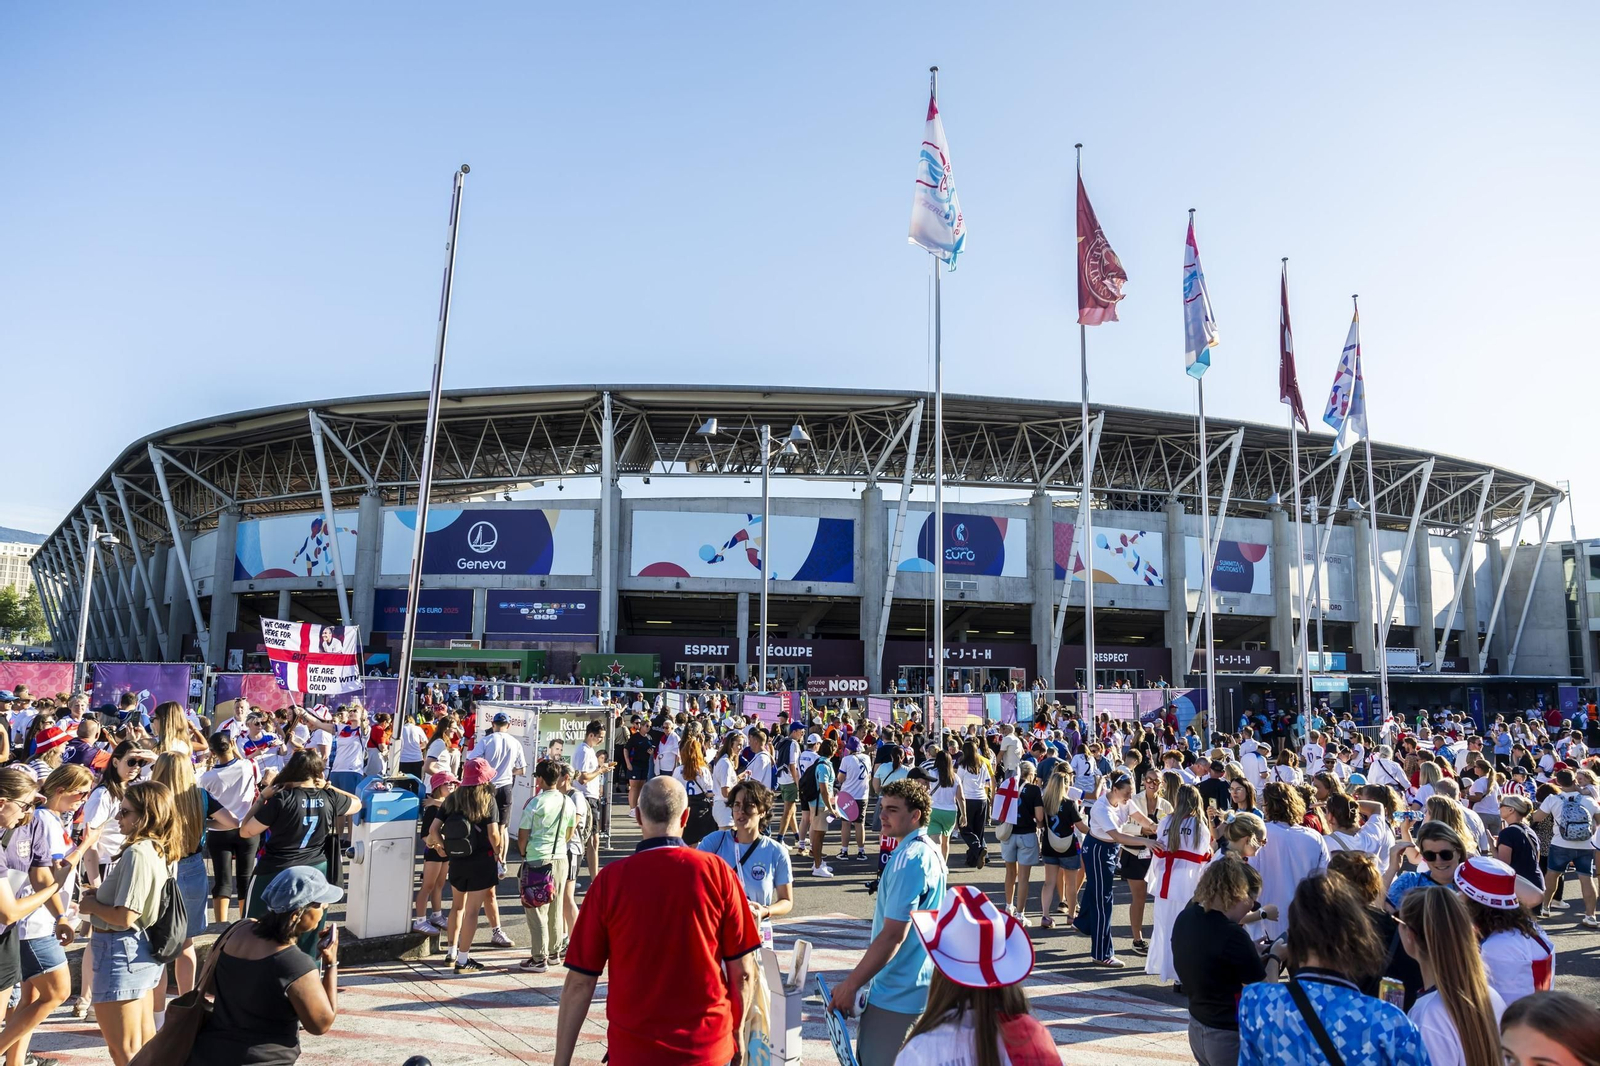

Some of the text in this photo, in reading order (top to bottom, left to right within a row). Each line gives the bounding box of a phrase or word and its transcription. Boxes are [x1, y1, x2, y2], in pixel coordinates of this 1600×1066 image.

[457, 558, 507, 570] Geneva
[264, 620, 292, 630] WE CAME
[264, 629, 292, 639] HERE FOR
[265, 637, 287, 647] BRONZE
[684, 644, 730, 656] ESPRIT
[320, 667, 335, 675] ARE
[309, 673, 360, 684] LEAVING WITH
[309, 683, 327, 691] GOLD
[828, 679, 868, 692] NORD
[858, 765, 866, 780] 2
[1083, 761, 1091, 777] 2
[301, 798, 325, 808] JAMES
[299, 815, 319, 849] 7
